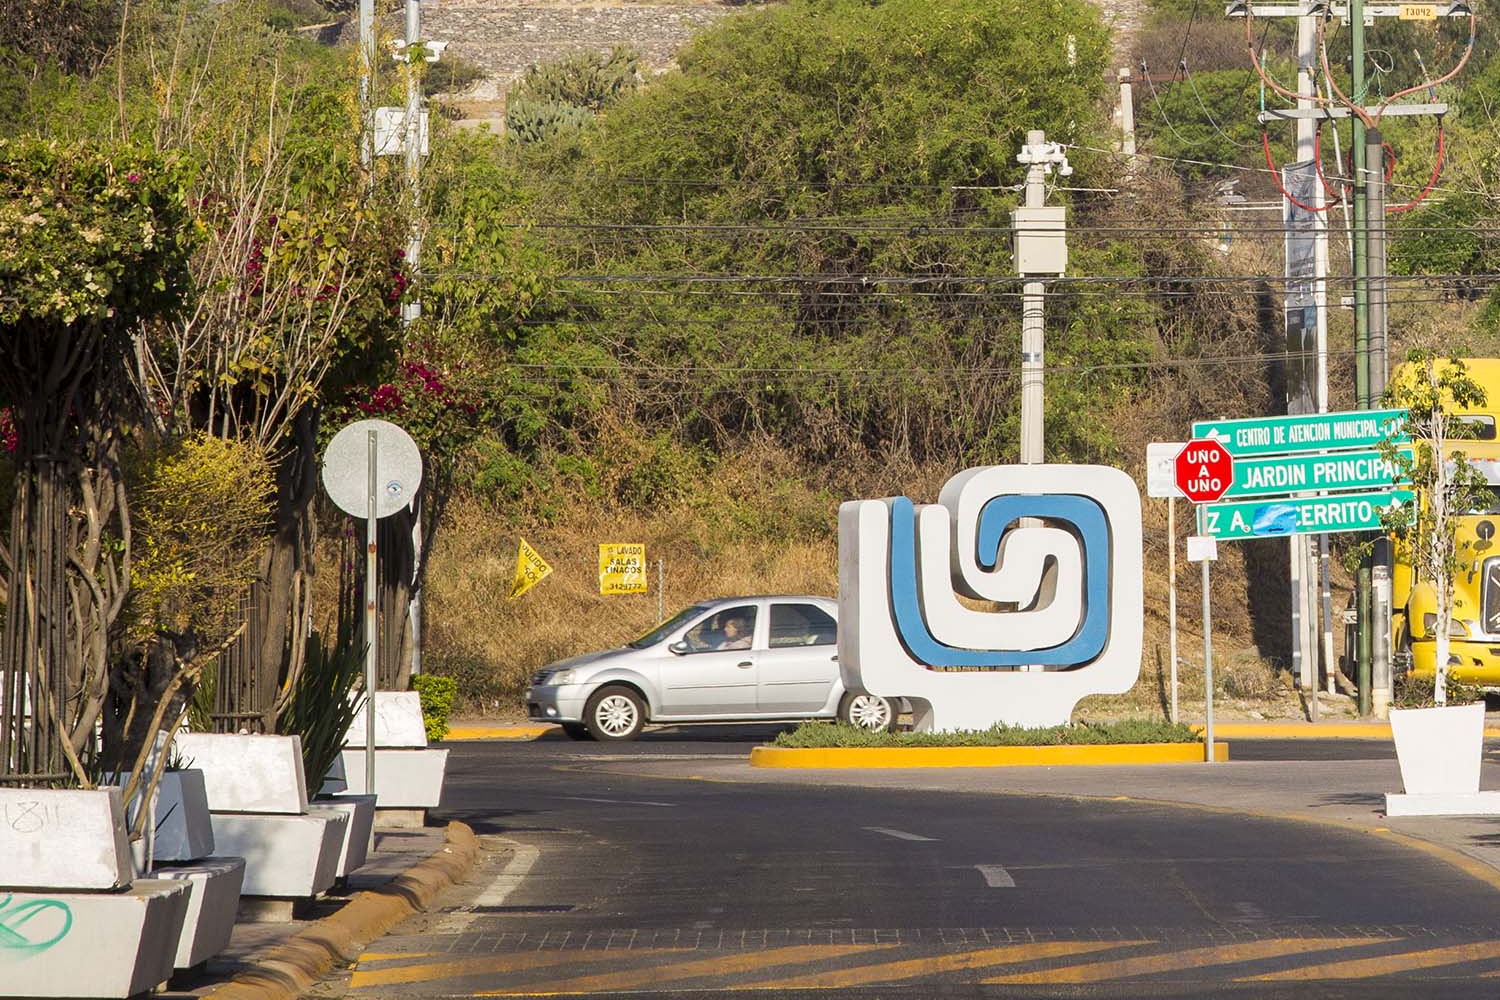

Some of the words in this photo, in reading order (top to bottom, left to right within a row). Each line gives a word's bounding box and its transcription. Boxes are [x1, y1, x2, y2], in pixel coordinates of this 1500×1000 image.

[1236, 427, 1270, 447] CENTRO
[1273, 426, 1286, 445] DE
[1288, 422, 1330, 443] ATENCION
[1186, 449, 1220, 464] UNO
[1198, 464, 1210, 478] A
[1242, 463, 1306, 489] JARDIN
[1187, 478, 1221, 493] UNO
[616, 546, 642, 555] LAVADO
[610, 558, 637, 566] SALAS
[604, 566, 642, 574] TINACOS
